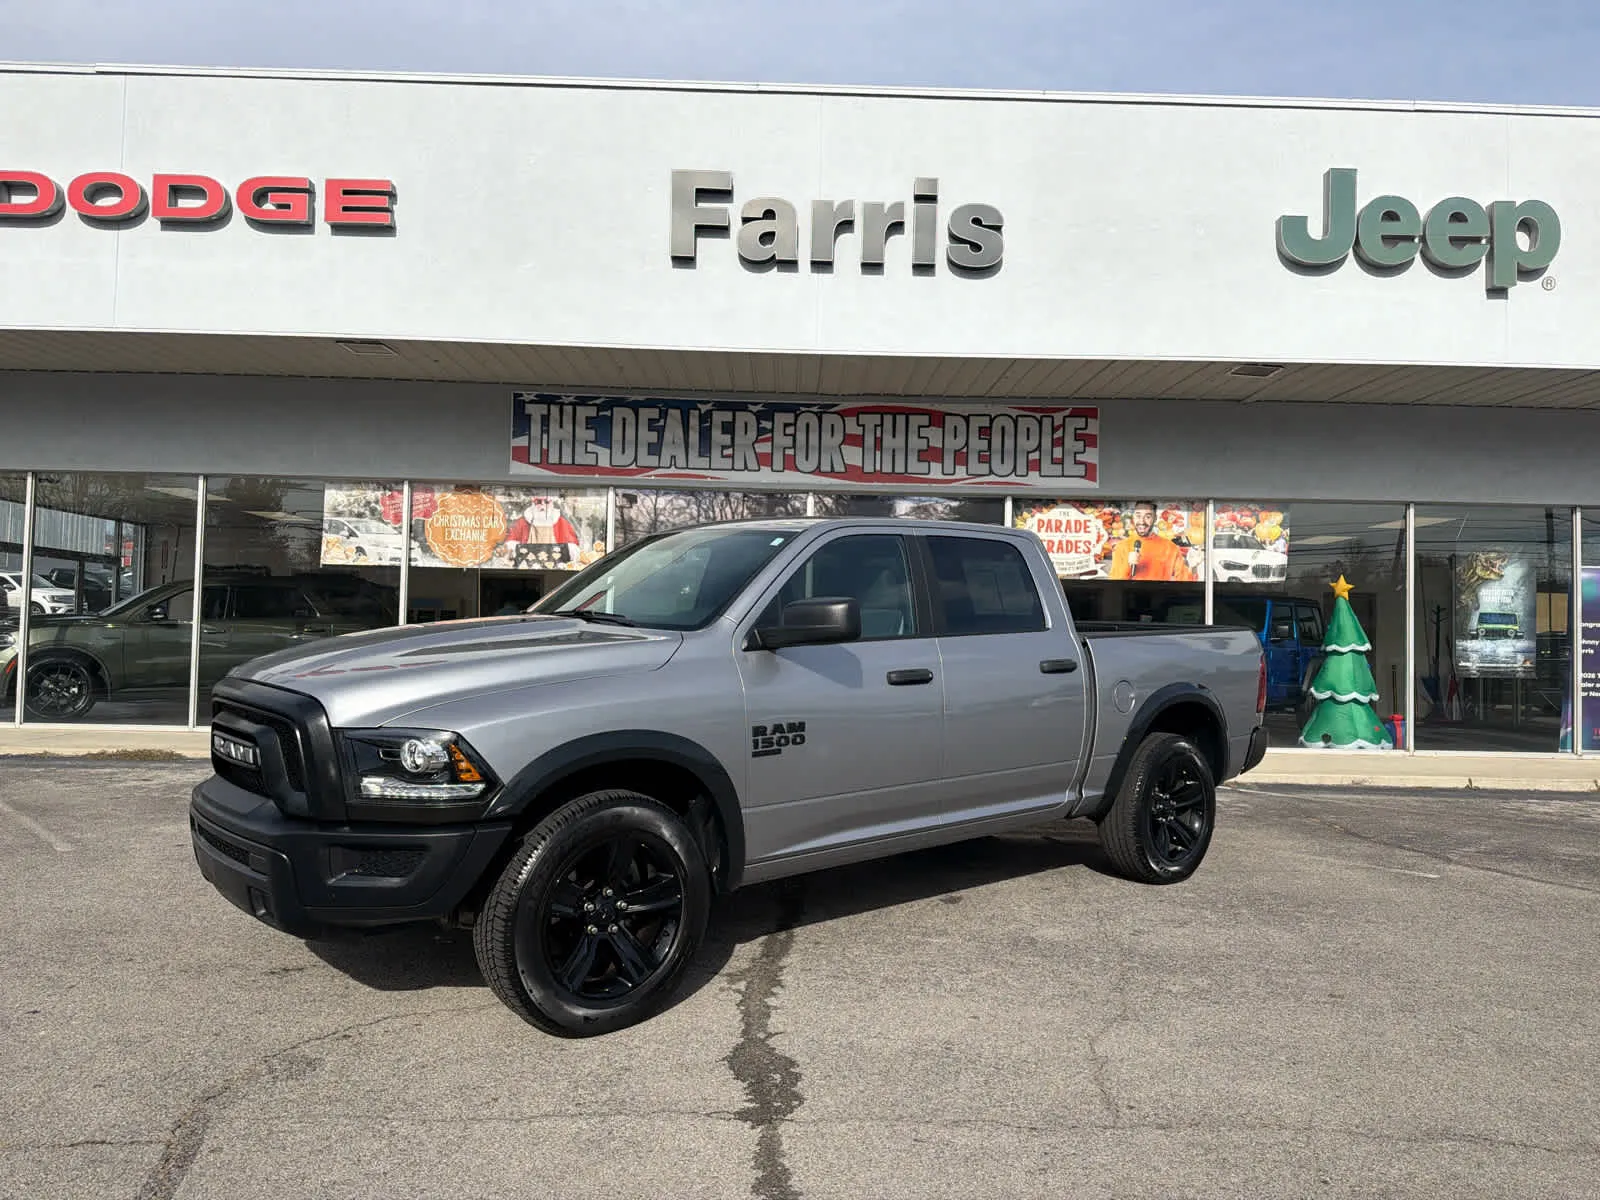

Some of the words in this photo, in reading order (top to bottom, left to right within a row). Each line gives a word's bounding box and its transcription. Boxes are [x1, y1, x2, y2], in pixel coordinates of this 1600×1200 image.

[0, 170, 395, 232] DODGE
[671, 169, 1005, 272] Farris
[1276, 168, 1561, 292] Jeep
[524, 401, 599, 466] THE
[609, 406, 760, 471] DEALER
[771, 409, 846, 473] FOR
[857, 412, 931, 475] THE
[942, 413, 1088, 477] PEOPLE
[434, 514, 480, 529] CHRISTMAS
[483, 514, 499, 528] CAR
[1037, 519, 1091, 534] PARADE
[1043, 540, 1092, 554] RADES
[751, 721, 806, 738] RAM
[213, 735, 254, 764] RAM
[752, 733, 806, 750] 1500
